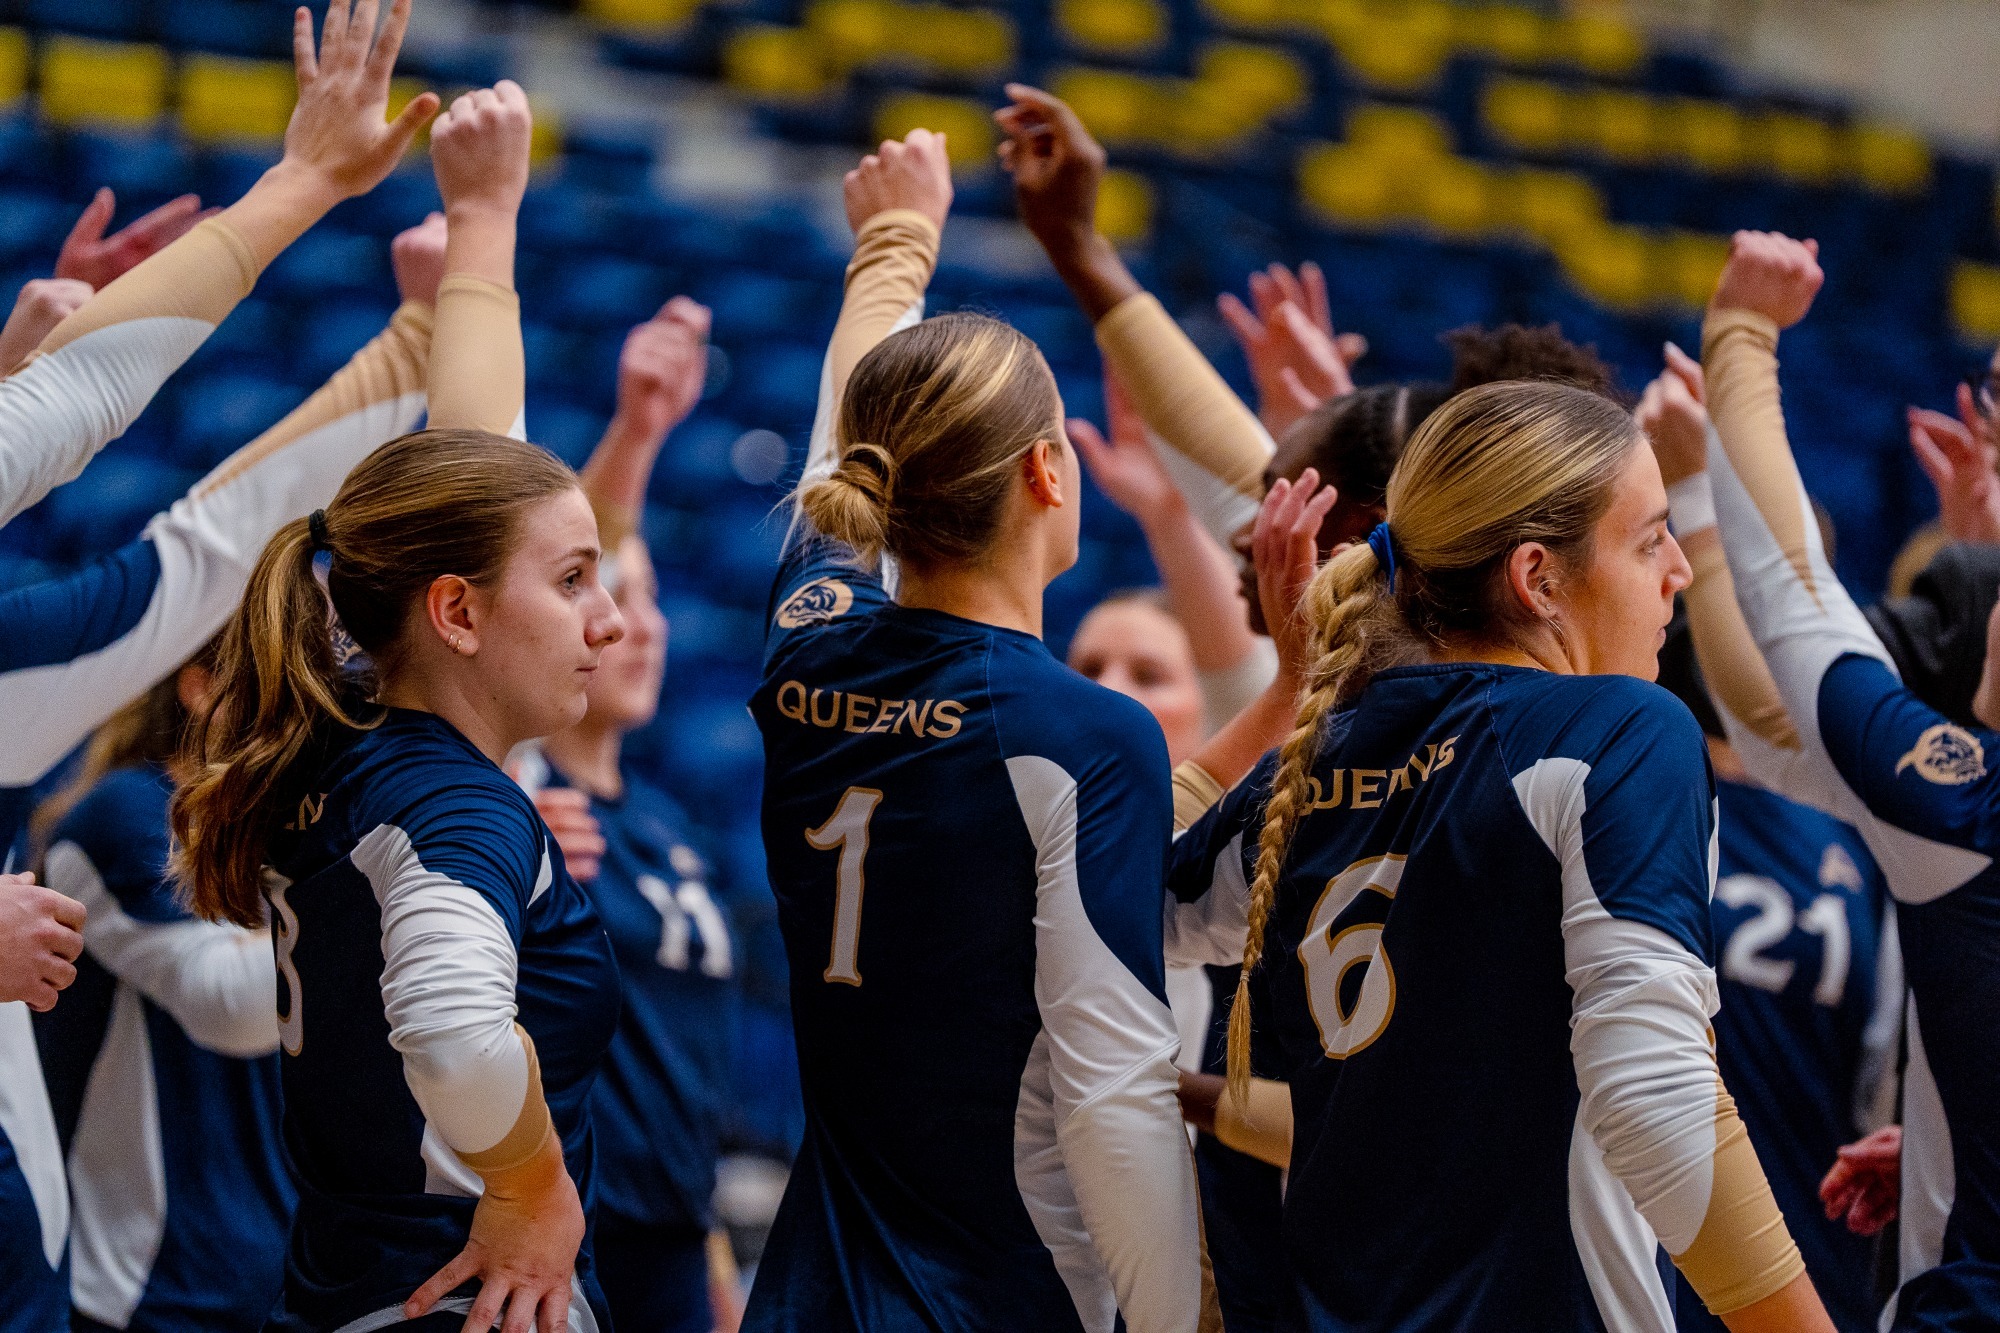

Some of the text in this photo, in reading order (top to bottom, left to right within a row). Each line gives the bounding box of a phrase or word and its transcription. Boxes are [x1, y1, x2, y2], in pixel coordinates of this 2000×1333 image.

[777, 680, 969, 738] QUEENS
[804, 785, 884, 987] 1
[1297, 852, 1408, 1061] 6
[1715, 873, 1851, 1007] 21
